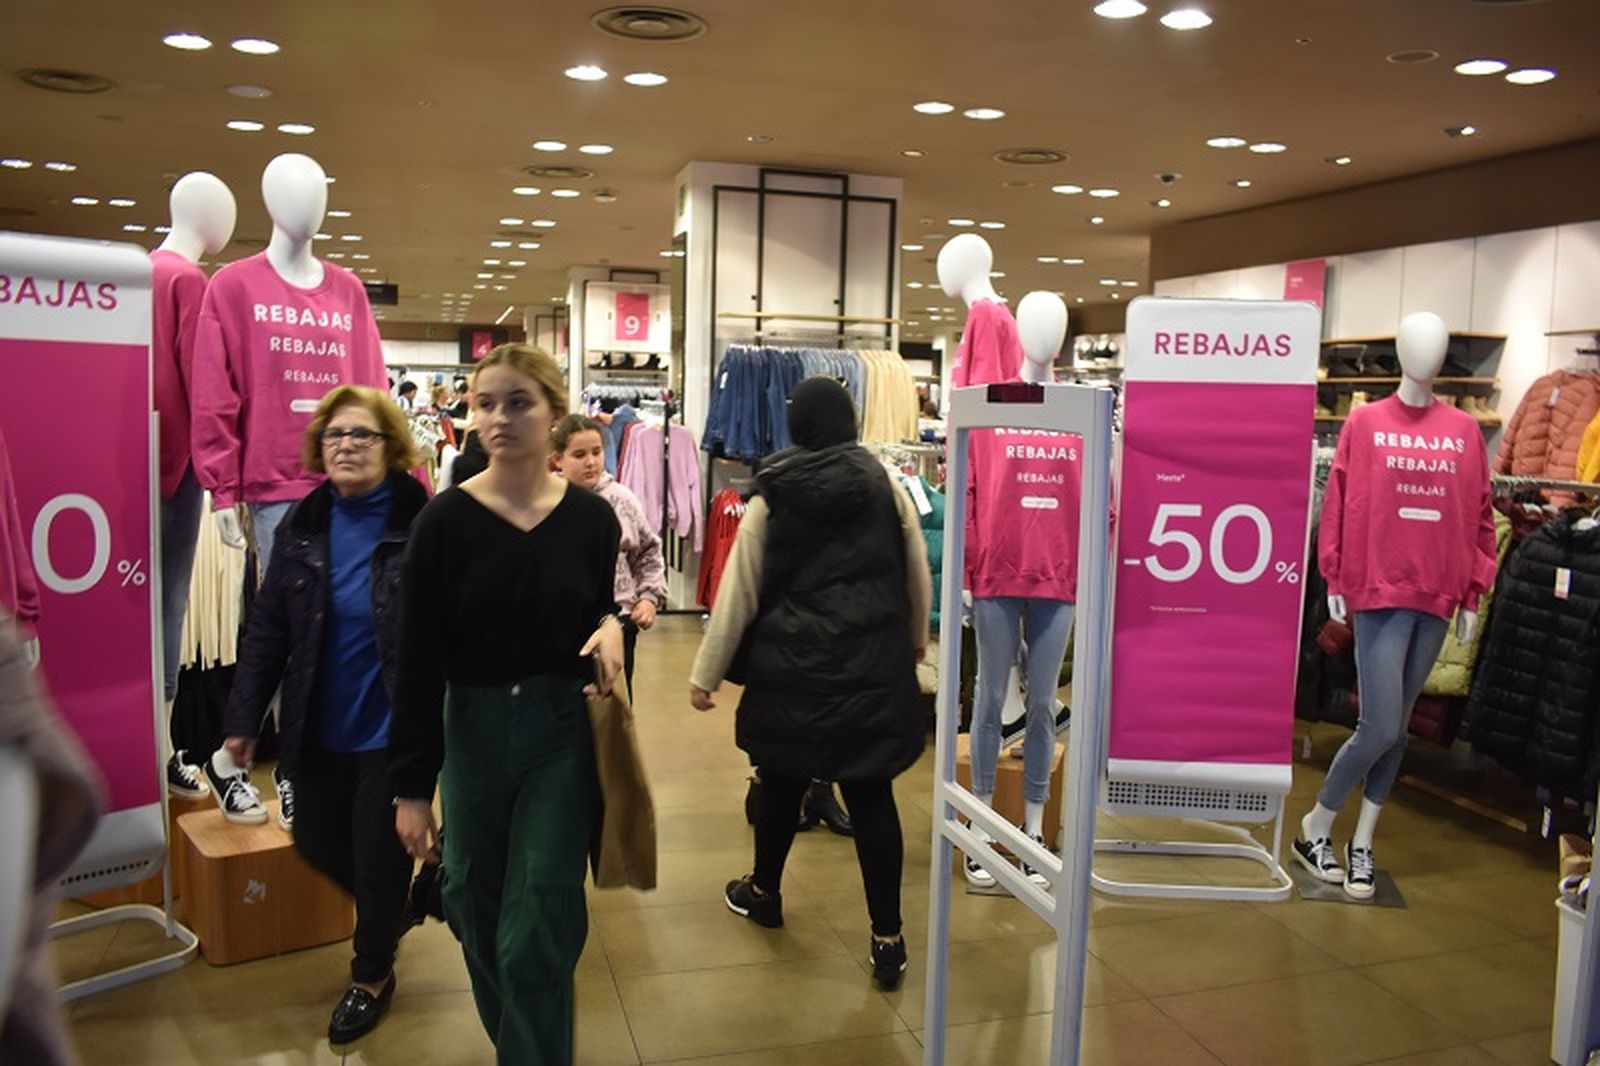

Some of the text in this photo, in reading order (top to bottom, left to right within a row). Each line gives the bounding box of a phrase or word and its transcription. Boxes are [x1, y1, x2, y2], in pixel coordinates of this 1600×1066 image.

[253, 303, 353, 332] REBAJAS
[625, 316, 640, 335] 9
[269, 336, 347, 358] REBAJAS
[1154, 332, 1292, 357] REBAJAS
[284, 369, 339, 385] REBAJAS
[1373, 431, 1465, 453] REBAJAS
[1006, 445, 1077, 462] REBAJAS
[1386, 455, 1456, 474] REBAJAS
[1017, 472, 1065, 485] REBAJAS
[1396, 483, 1446, 497] REBAJAS
